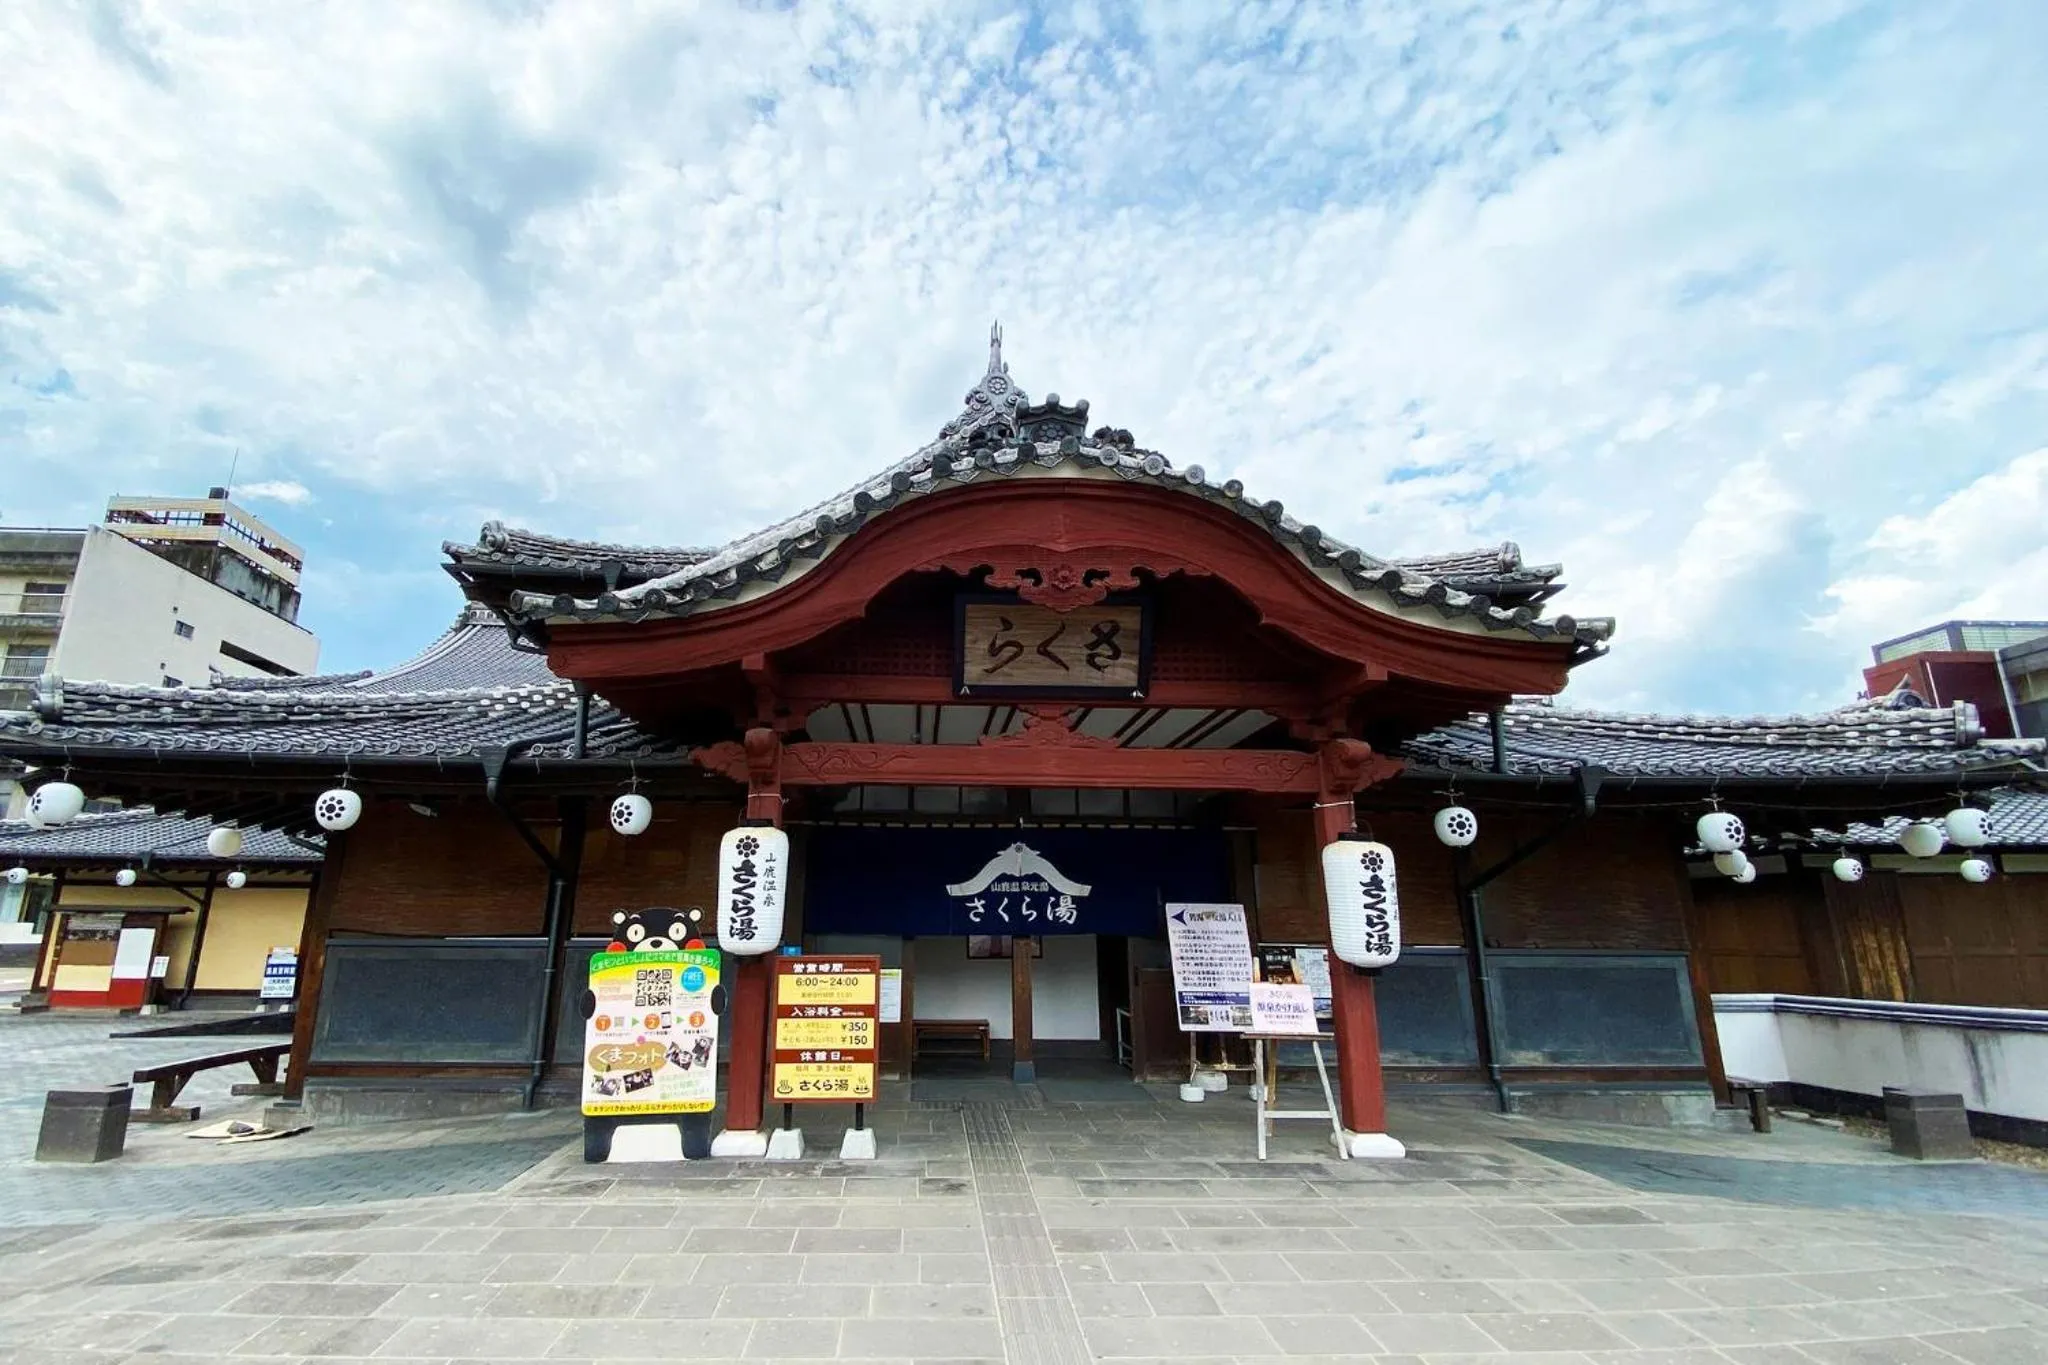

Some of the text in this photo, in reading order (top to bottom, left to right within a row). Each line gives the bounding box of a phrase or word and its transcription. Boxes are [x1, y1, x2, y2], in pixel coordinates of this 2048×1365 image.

[763, 852, 777, 907] 山鹿温泉
[729, 859, 758, 940] さくら湯
[965, 895, 1077, 925] さくら湯
[1359, 874, 1393, 956] さくら湯
[791, 1006, 842, 1016] 入浴料金
[597, 1046, 660, 1064] くまフォト
[800, 1051, 840, 1061] 休館日
[799, 1079, 849, 1091] さくら湯
